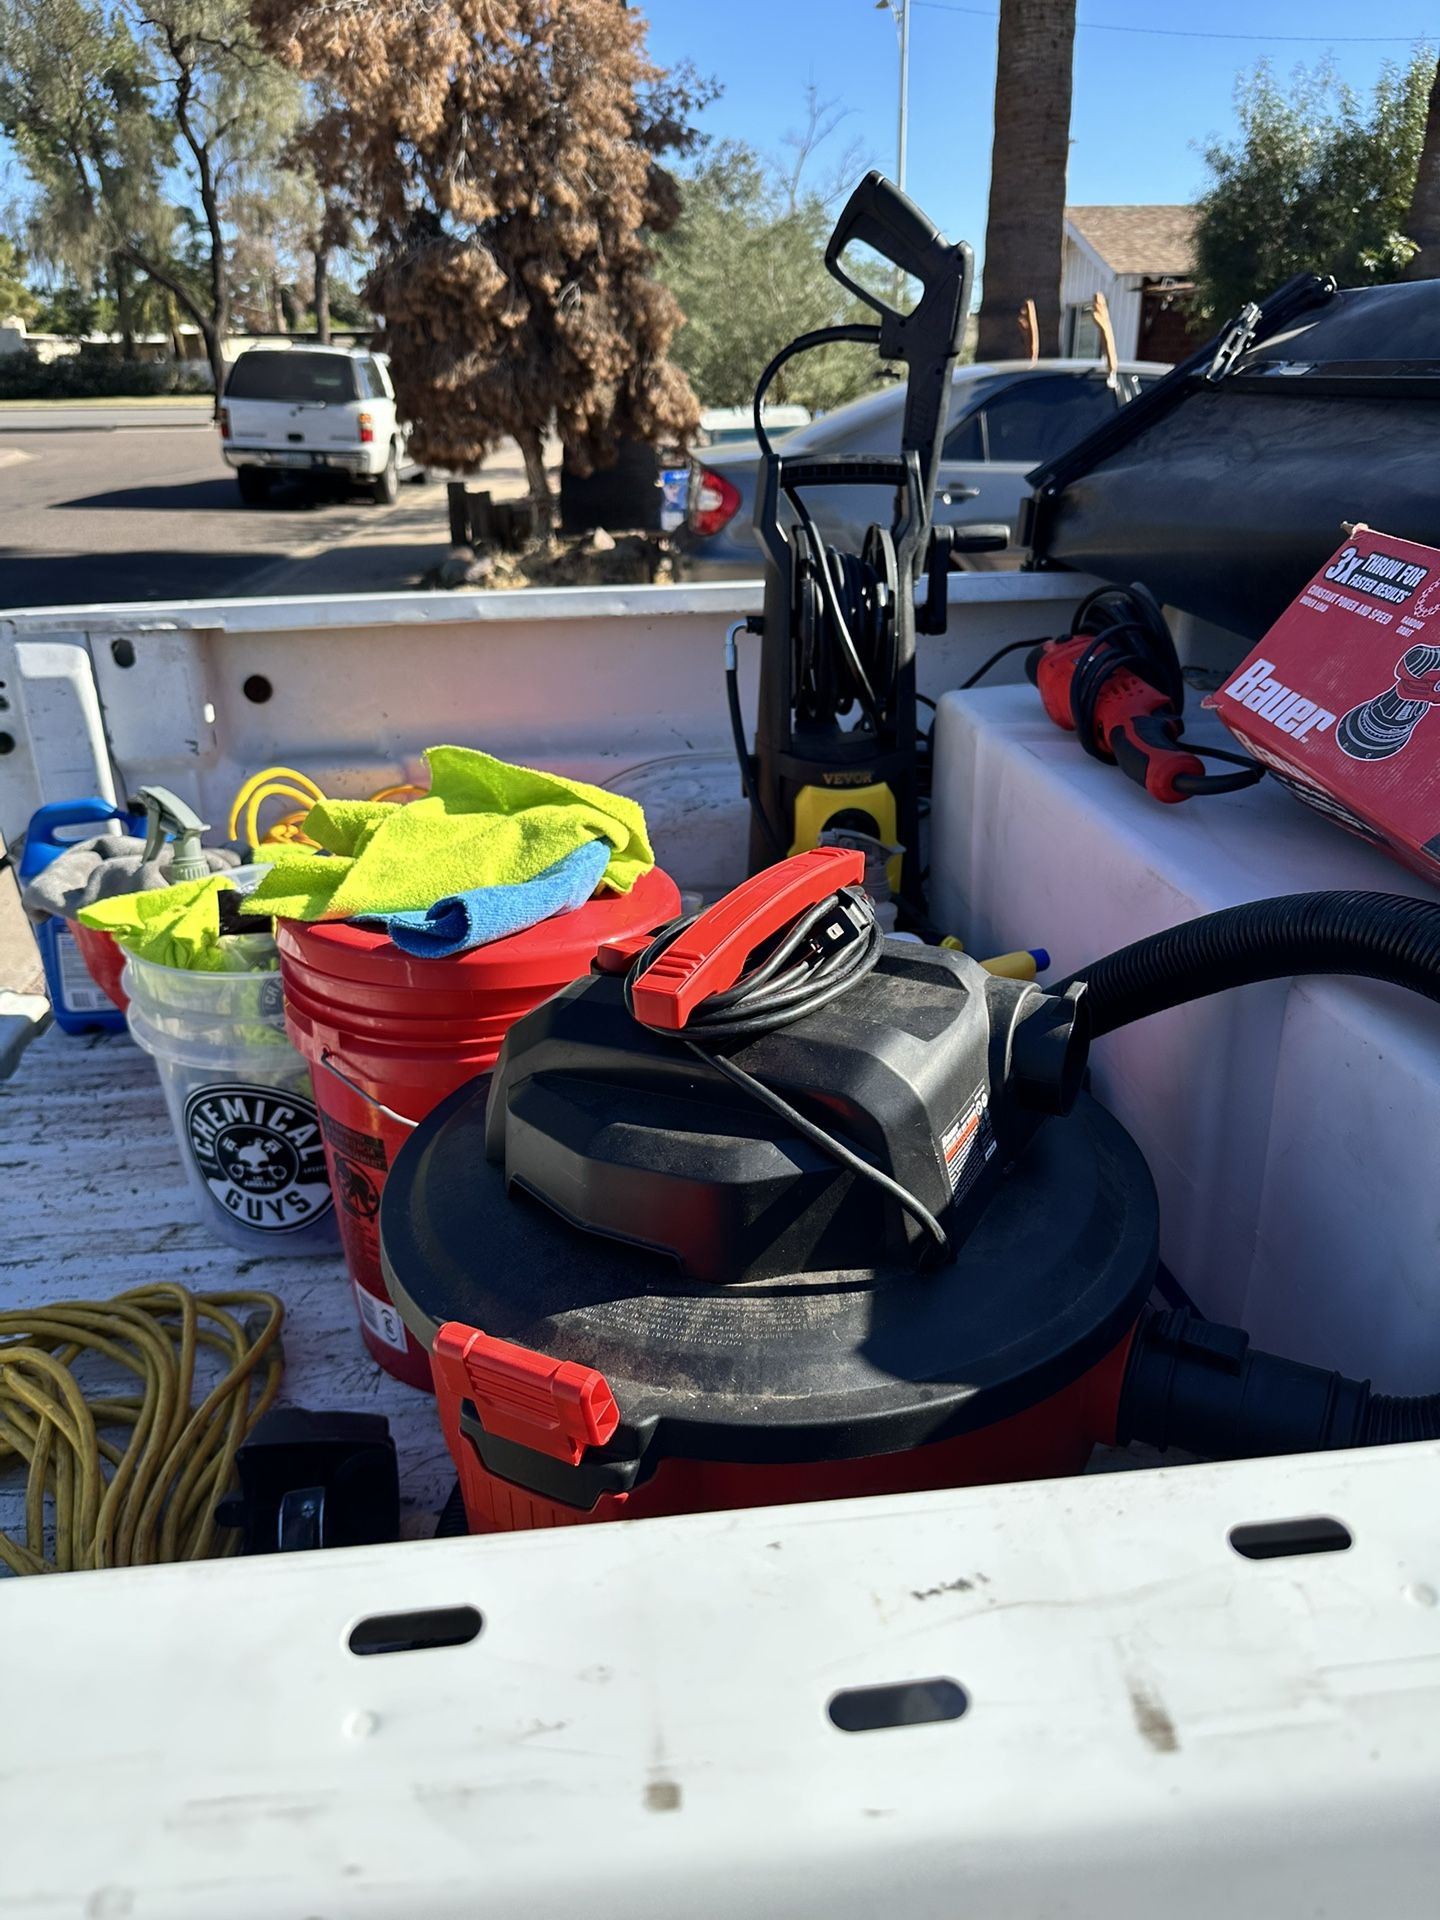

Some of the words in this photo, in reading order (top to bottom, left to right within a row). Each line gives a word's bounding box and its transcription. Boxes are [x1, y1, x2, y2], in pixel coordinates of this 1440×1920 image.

[1347, 574, 1378, 592] FASTER
[1361, 553, 1404, 579] THROW
[1396, 565, 1427, 587] FOR
[1307, 585, 1341, 603] CONSTANT
[1334, 594, 1360, 612] POWER
[1354, 603, 1374, 617] AND
[1367, 607, 1393, 625] SPEED
[1224, 658, 1337, 741] Bauer
[823, 772, 872, 784] VEVOR
[194, 1097, 323, 1161] CHEMICAL
[225, 1190, 311, 1222] GUYS
